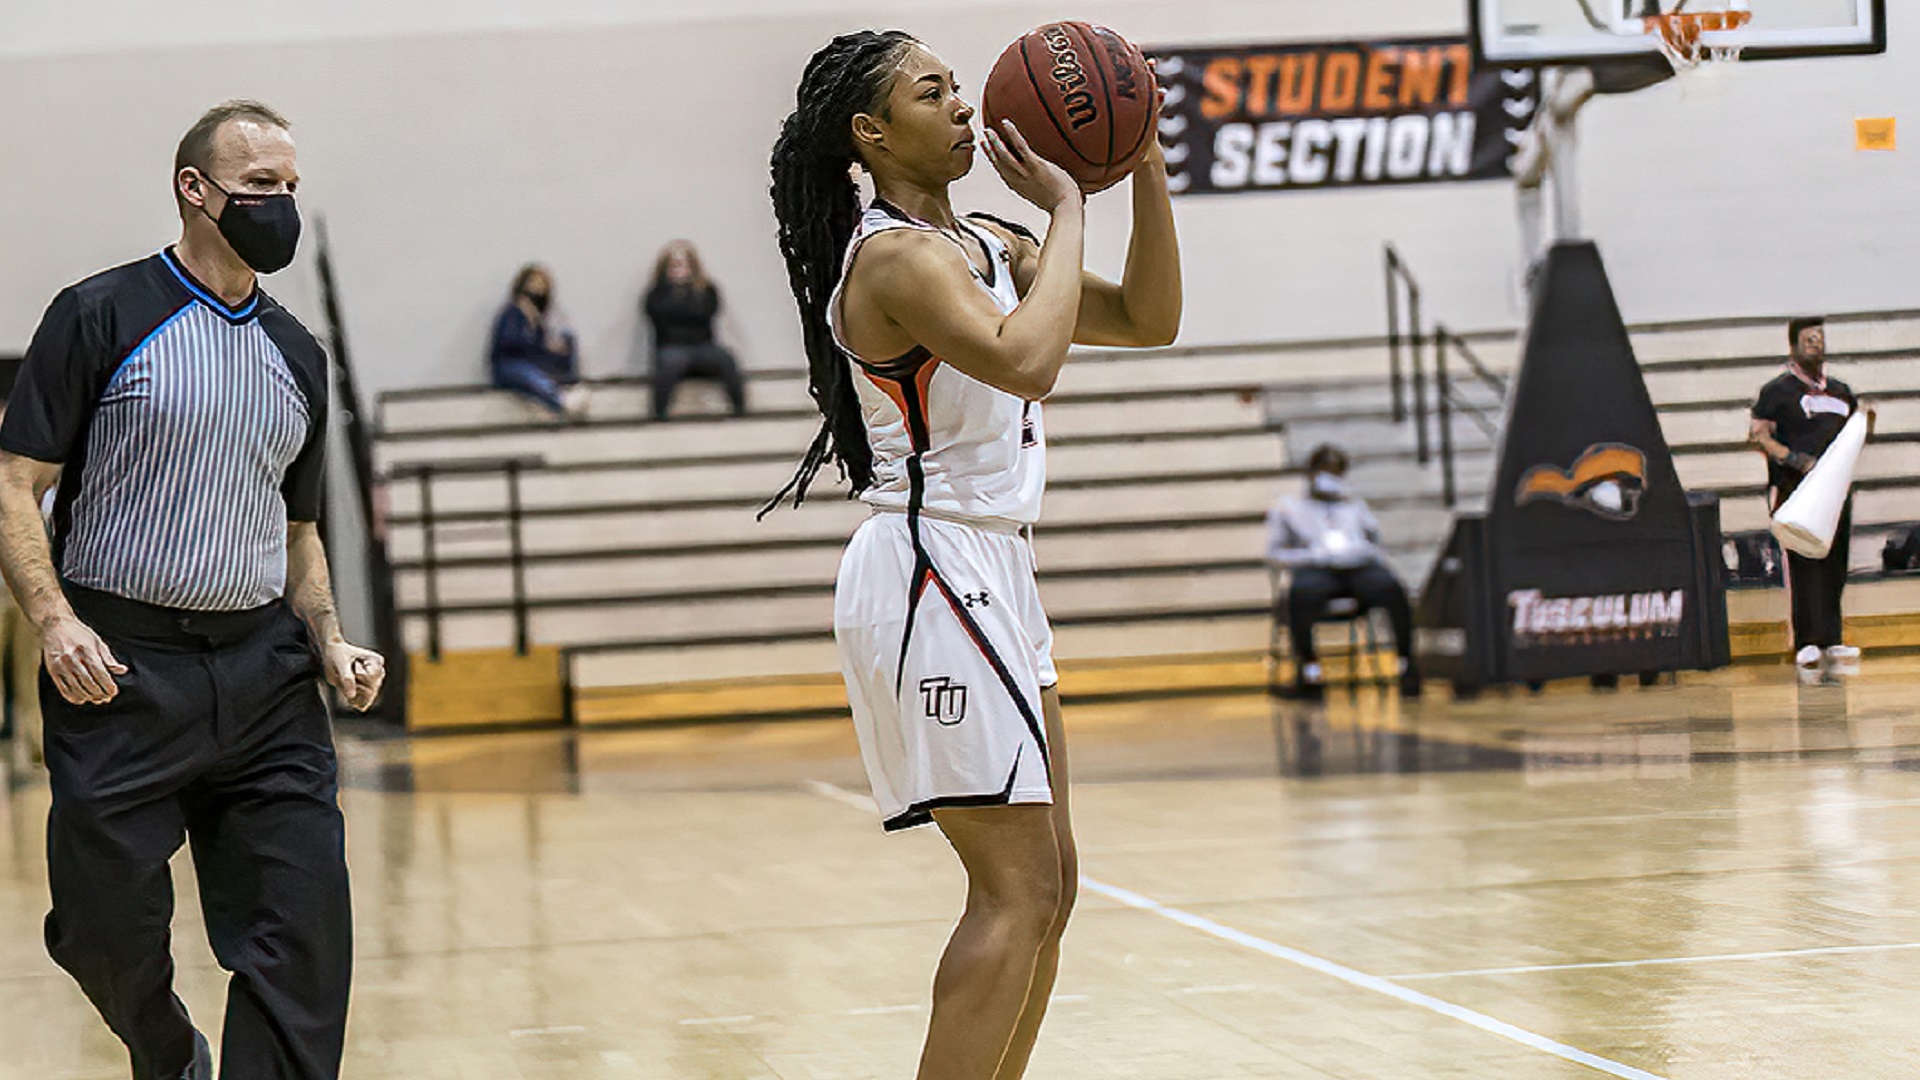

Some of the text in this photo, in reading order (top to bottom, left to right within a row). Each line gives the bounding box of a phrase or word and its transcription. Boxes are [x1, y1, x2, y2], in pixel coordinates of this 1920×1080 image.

[1201, 44, 1471, 119] STUDENT
[1210, 111, 1477, 188] SECTION
[919, 676, 967, 725] TU
